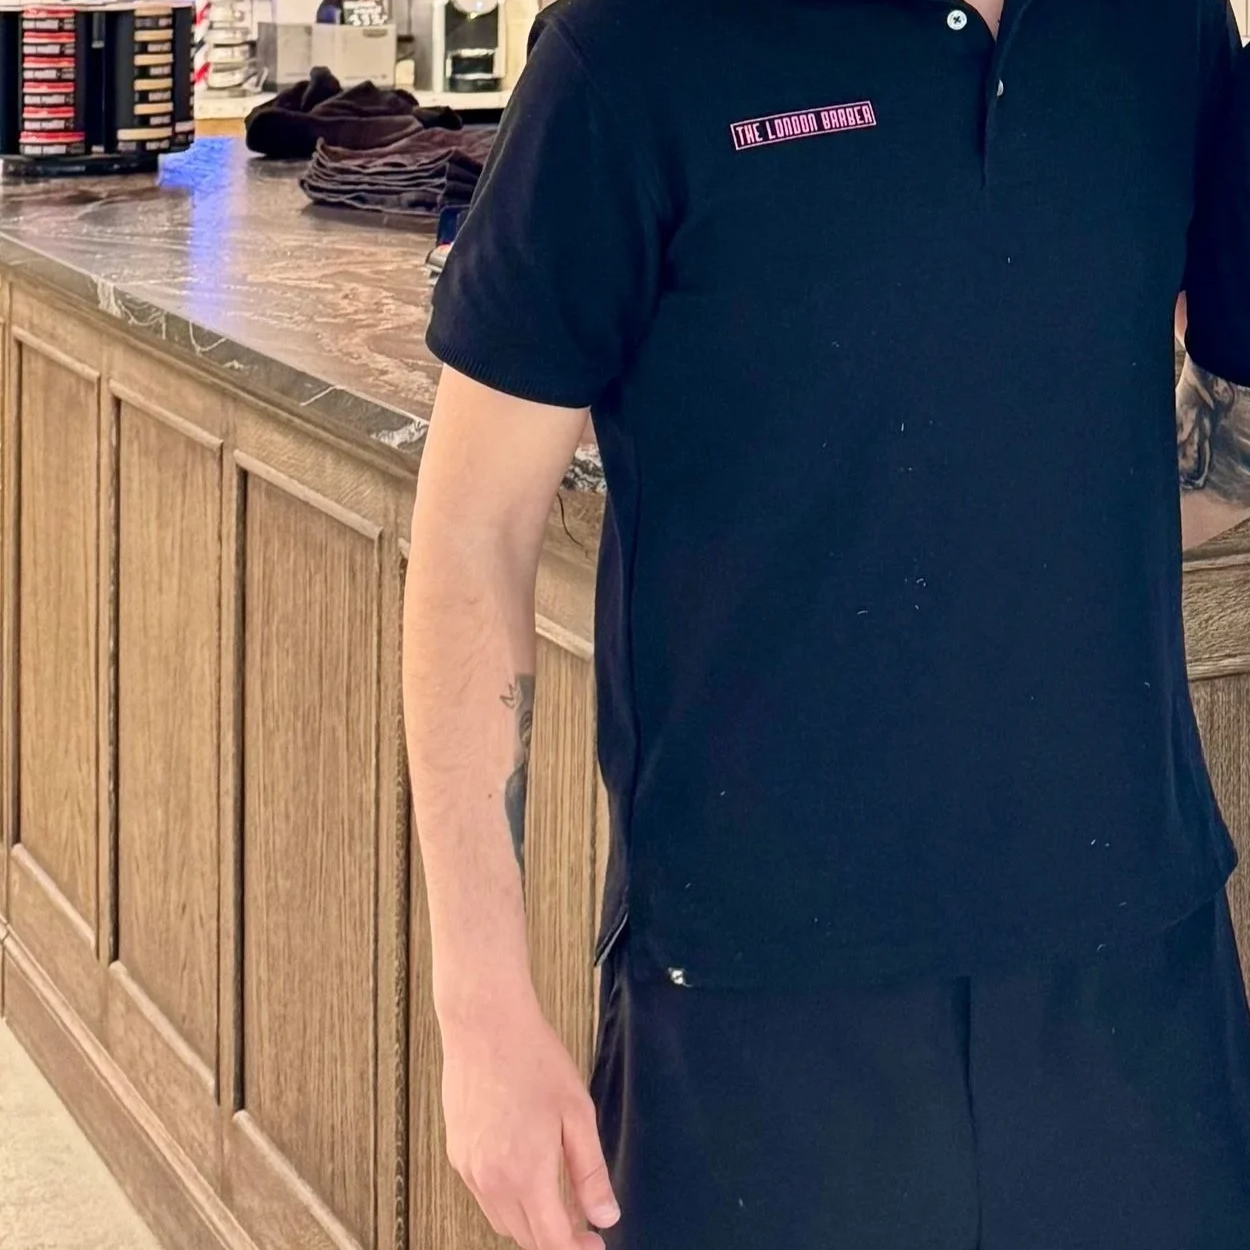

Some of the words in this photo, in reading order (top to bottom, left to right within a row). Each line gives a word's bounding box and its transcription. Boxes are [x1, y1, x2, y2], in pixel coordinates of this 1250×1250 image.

[736, 123, 763, 146] THE
[766, 112, 818, 140] LONDON
[820, 105, 873, 130] BARBER
